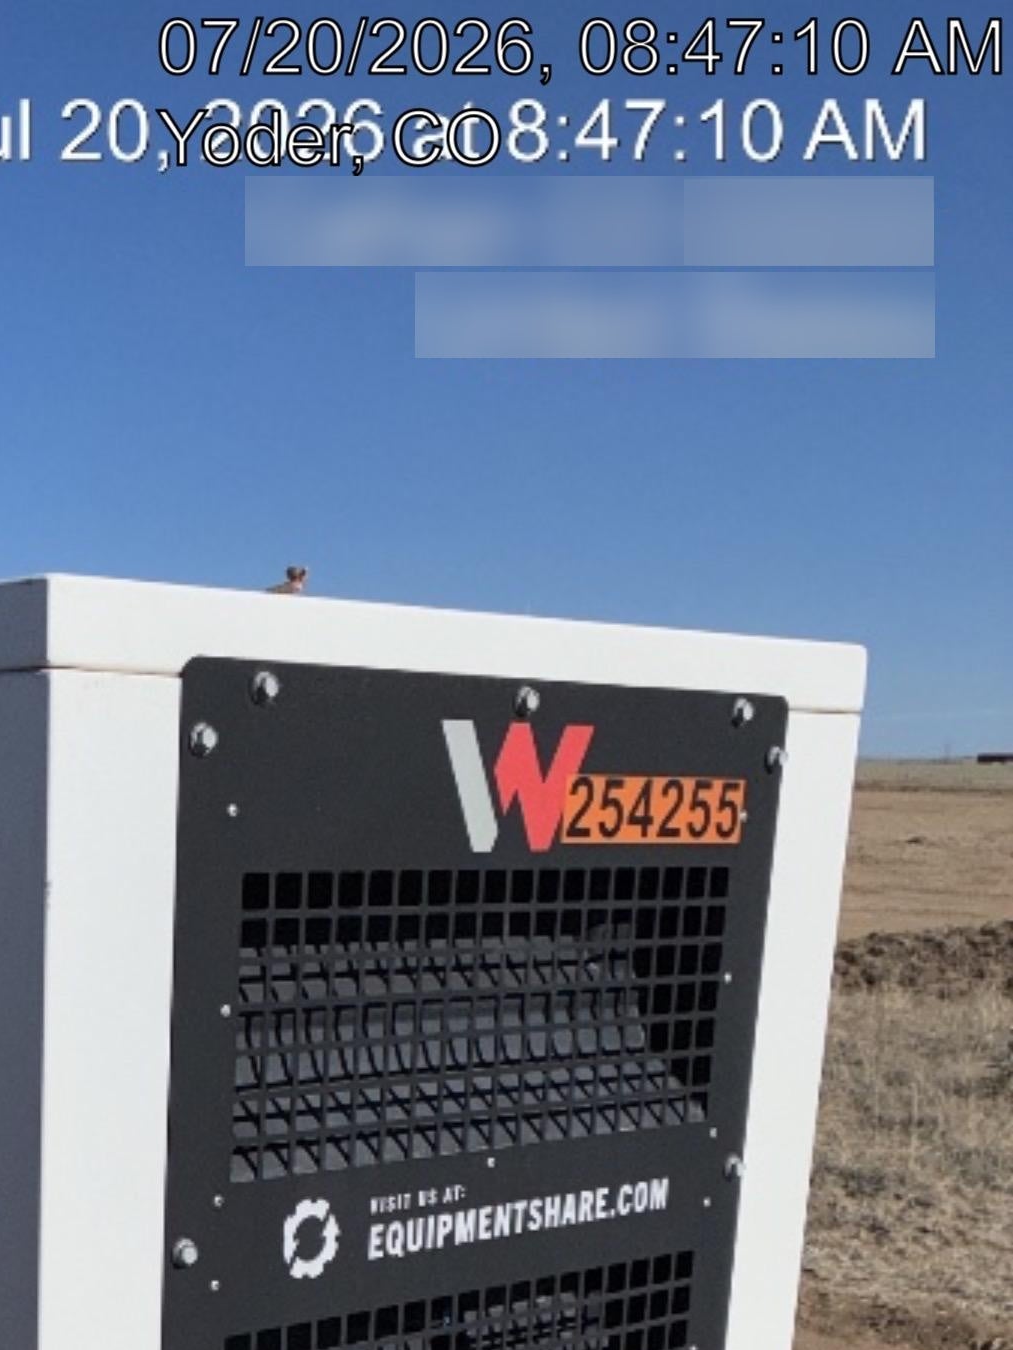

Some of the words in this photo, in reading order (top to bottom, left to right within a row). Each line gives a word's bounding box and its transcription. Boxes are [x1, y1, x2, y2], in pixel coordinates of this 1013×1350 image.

[565, 776, 740, 838] 254255
[367, 1177, 670, 1261] EQUIPMENTSHARE.COM
[370, 1193, 412, 1216] VISIT
[418, 1187, 438, 1207] US
[442, 1184, 466, 1204] AT:
